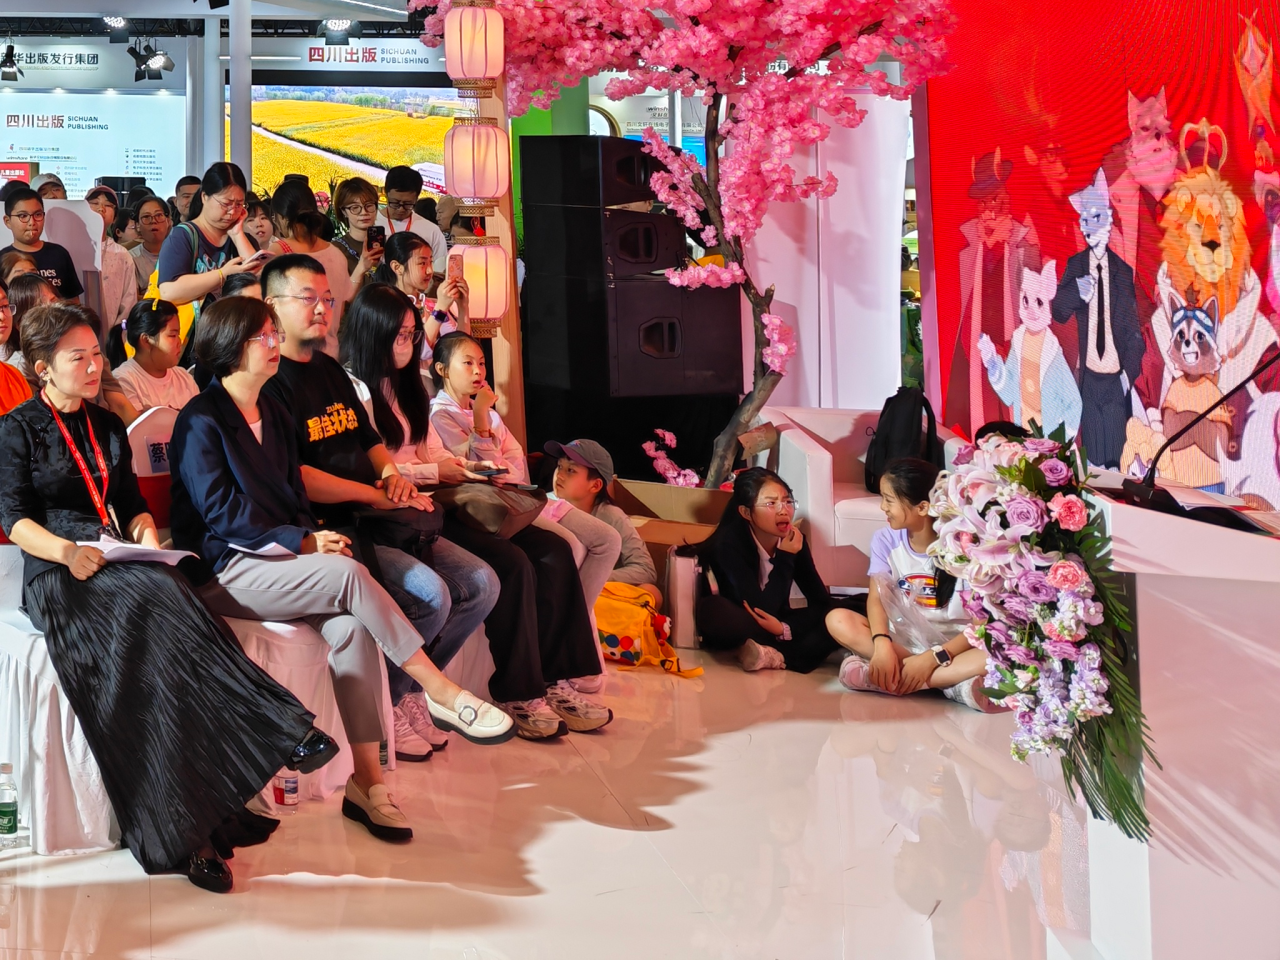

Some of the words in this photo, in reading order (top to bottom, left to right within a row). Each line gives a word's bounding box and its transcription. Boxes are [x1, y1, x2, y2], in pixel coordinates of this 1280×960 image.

[308, 46, 378, 63] 四川出版
[380, 47, 418, 55] SICHUAN
[380, 57, 430, 65] PUBLISHING
[6, 114, 65, 129] 四川出版
[307, 407, 359, 442] 最佳状态
